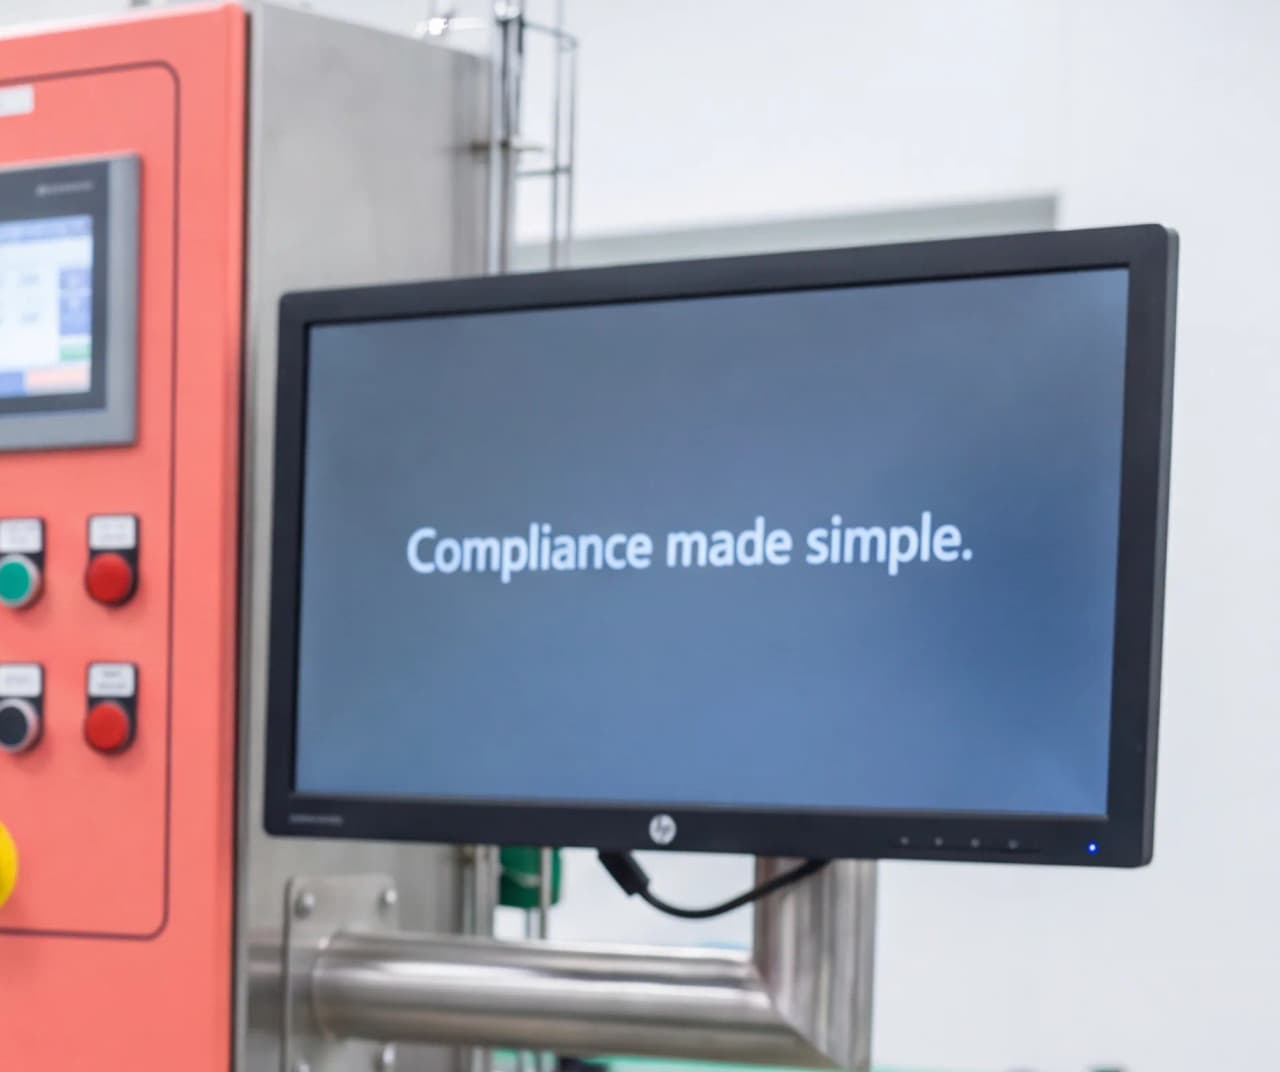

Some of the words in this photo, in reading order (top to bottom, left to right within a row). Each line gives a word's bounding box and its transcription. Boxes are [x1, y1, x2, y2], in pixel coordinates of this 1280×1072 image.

[407, 522, 654, 584] Compliance
[666, 515, 794, 568] made
[805, 511, 974, 577] simple.
